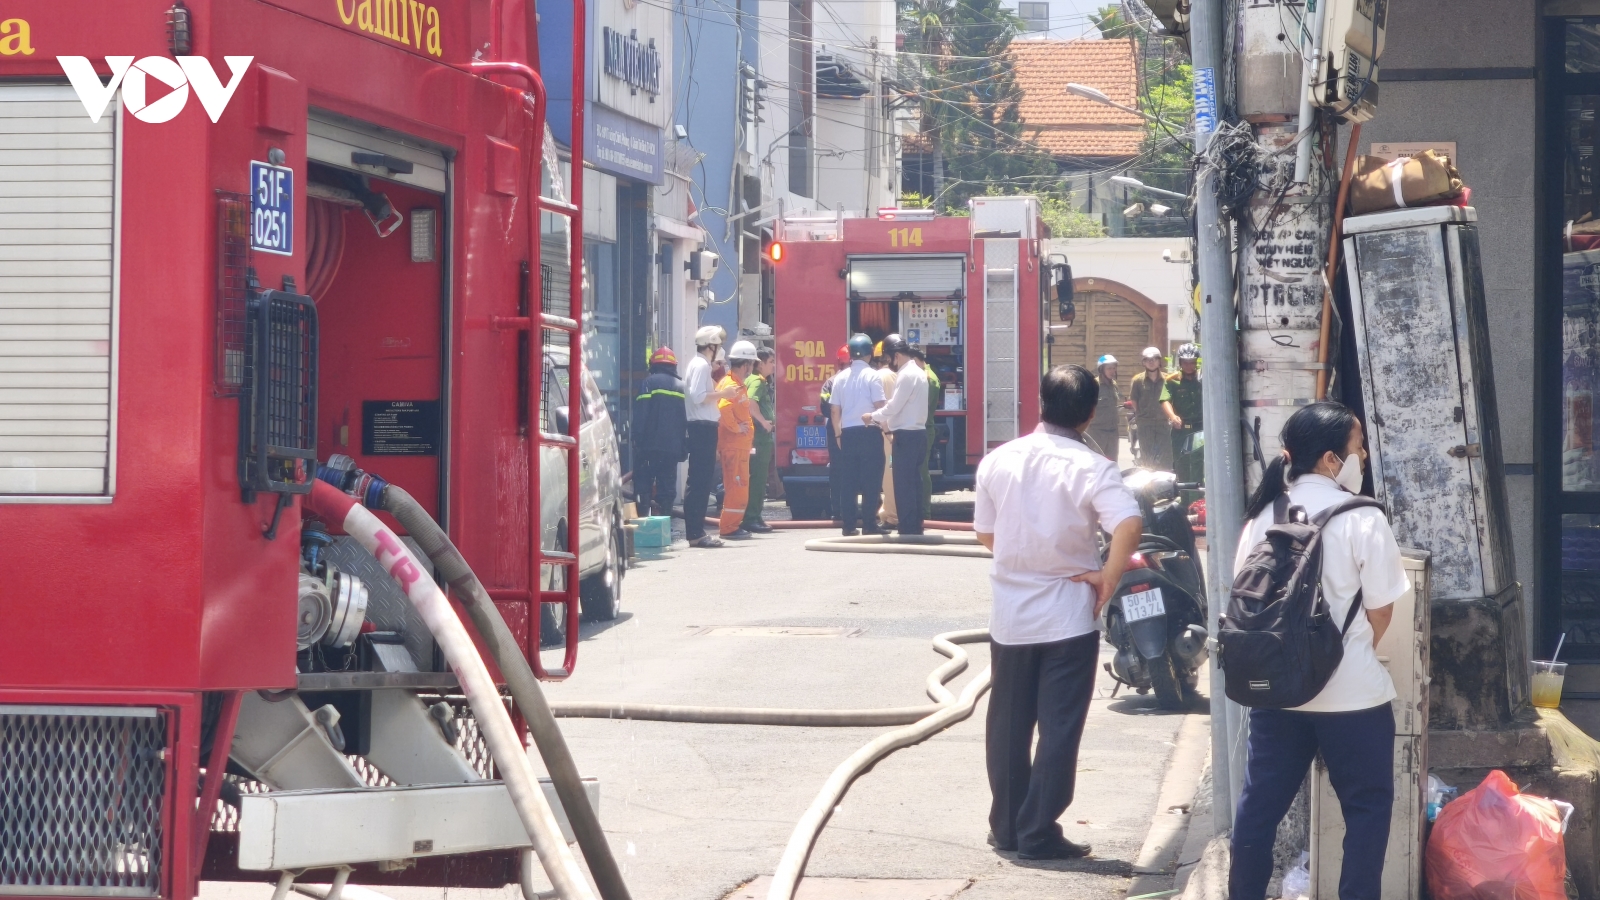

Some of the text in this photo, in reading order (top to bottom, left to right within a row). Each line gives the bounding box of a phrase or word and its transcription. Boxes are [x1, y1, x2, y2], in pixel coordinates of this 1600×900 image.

[259, 167, 285, 208] 51F
[255, 207, 286, 249] 0251
[887, 227, 924, 247] 114
[795, 341, 826, 358] 50A
[786, 364, 835, 381] 015.75
